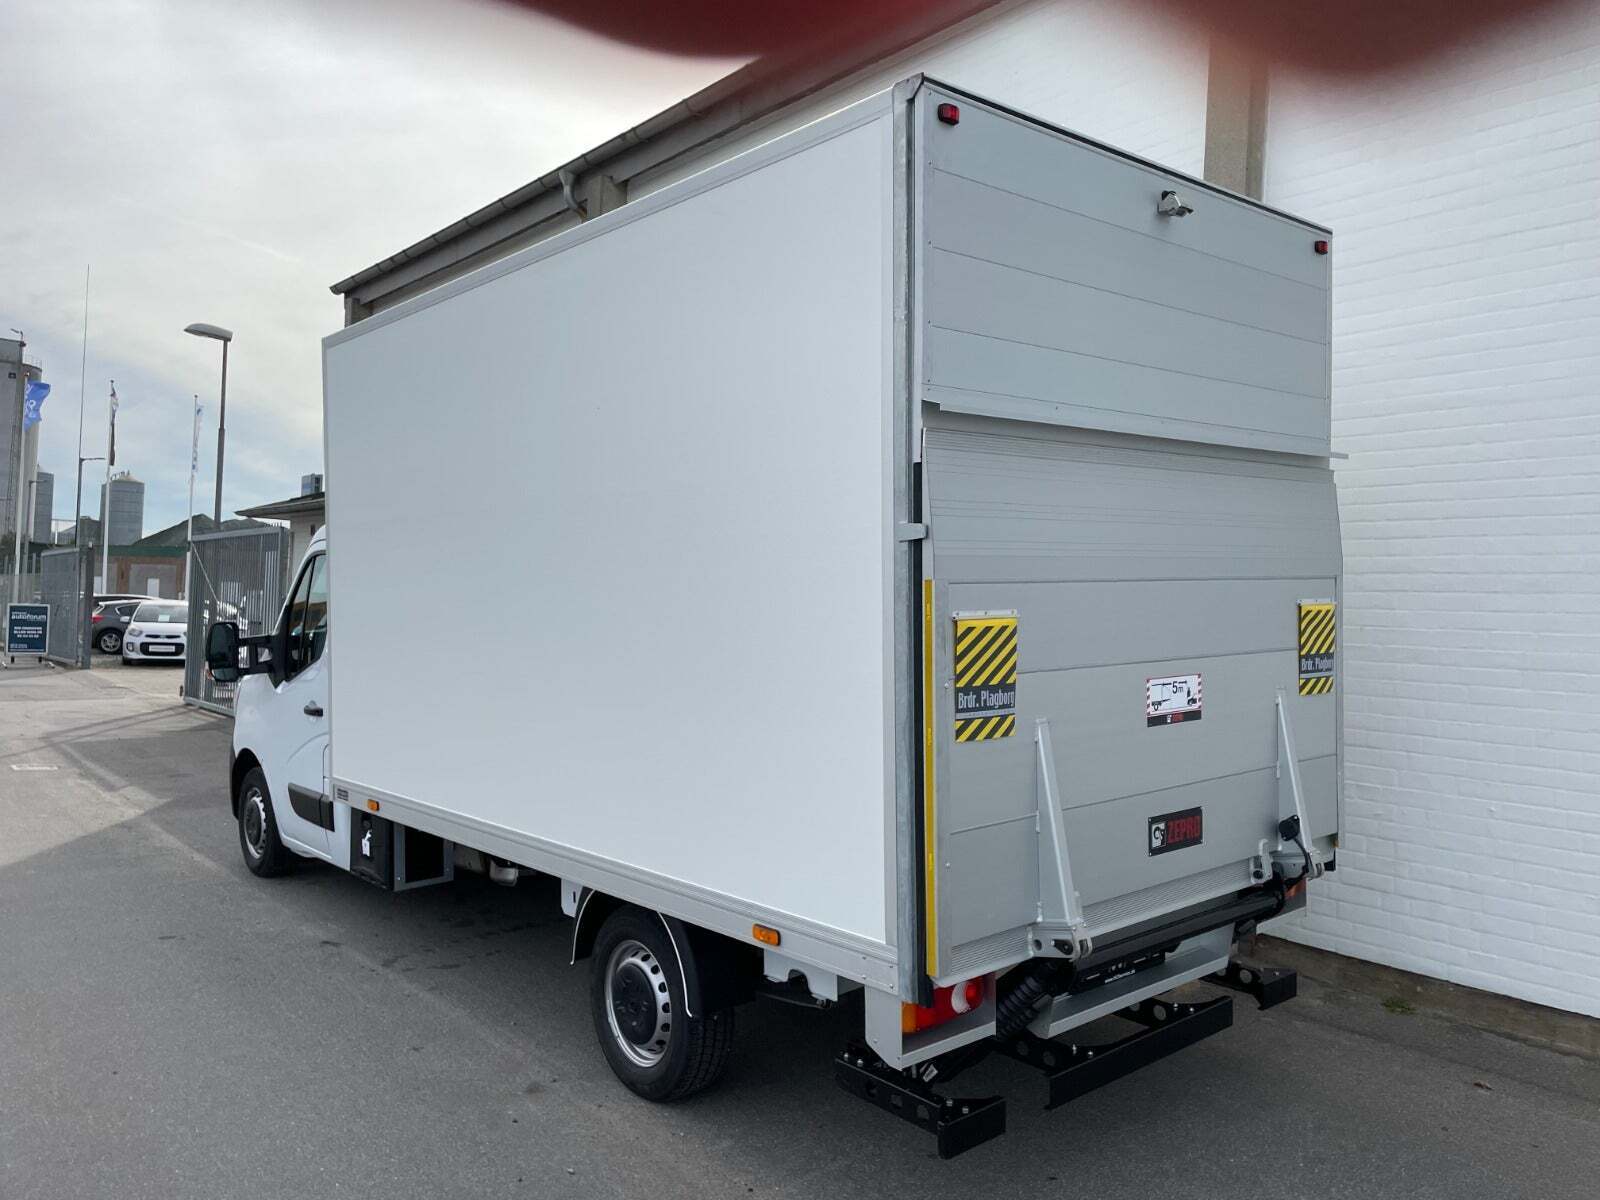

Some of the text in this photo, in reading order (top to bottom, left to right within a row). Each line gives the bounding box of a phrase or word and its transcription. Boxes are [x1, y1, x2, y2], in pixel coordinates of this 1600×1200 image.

[958, 690, 1015, 709] Brdr. Plagborg
[1167, 815, 1202, 844] ZEPRO
